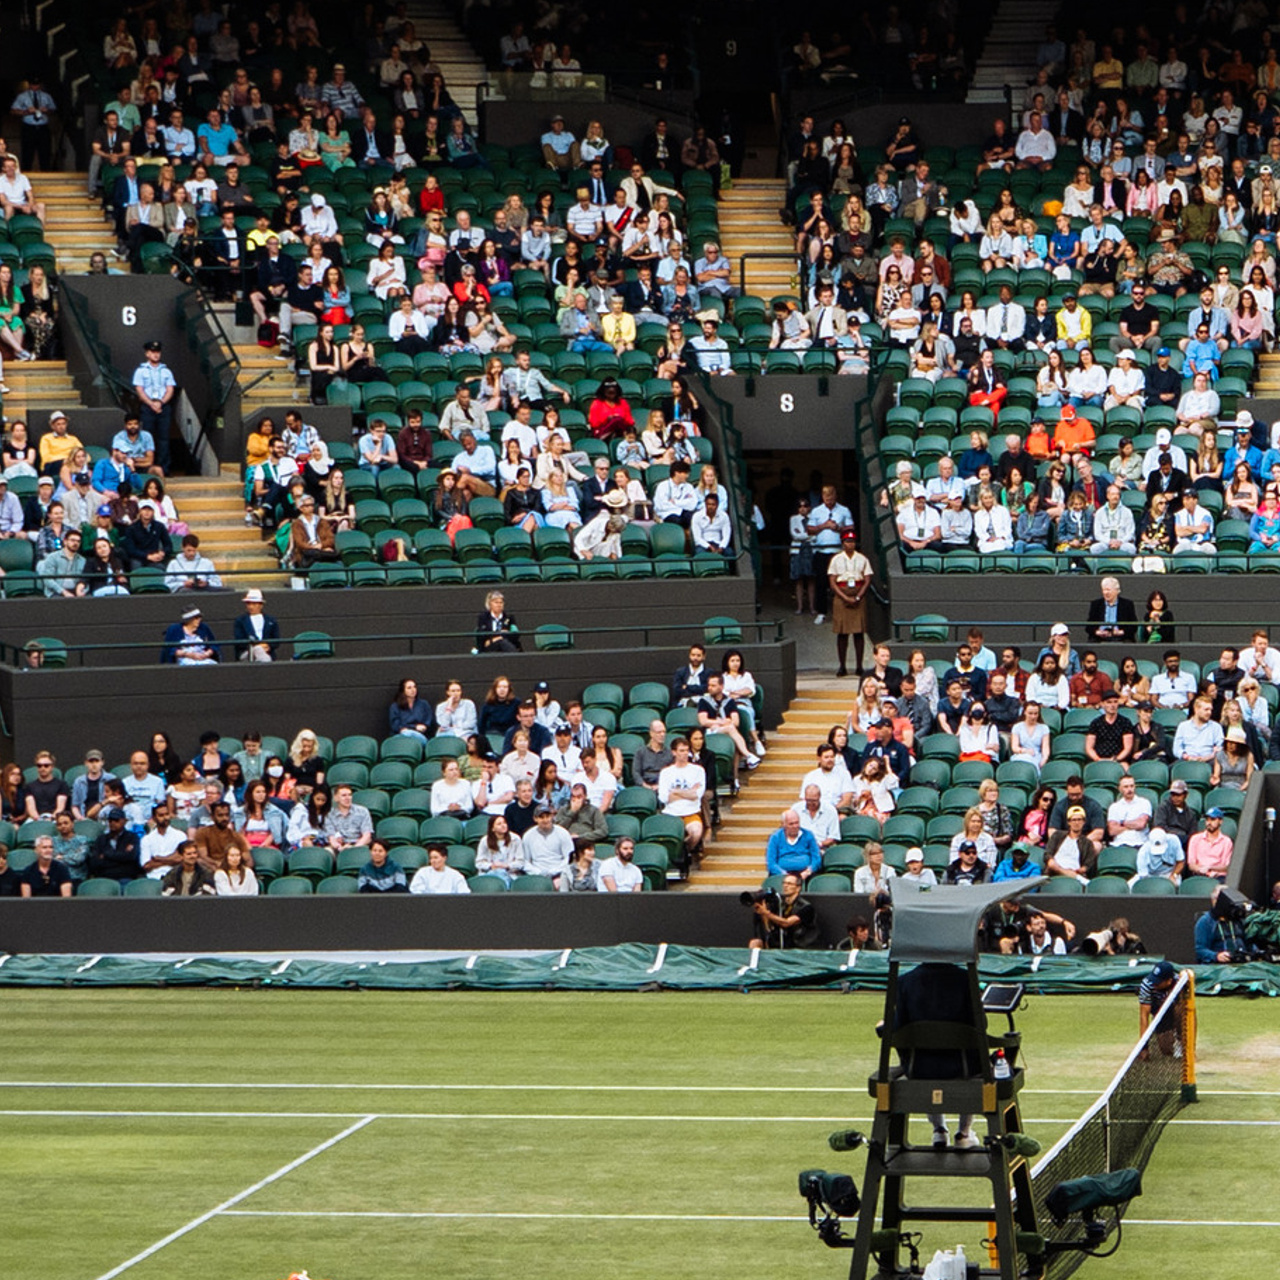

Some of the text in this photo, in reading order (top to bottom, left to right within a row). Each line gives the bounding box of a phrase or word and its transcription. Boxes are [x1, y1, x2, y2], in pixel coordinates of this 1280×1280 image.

[726, 40, 737, 56] 9
[122, 305, 136, 326] 6
[780, 393, 794, 412] 8
